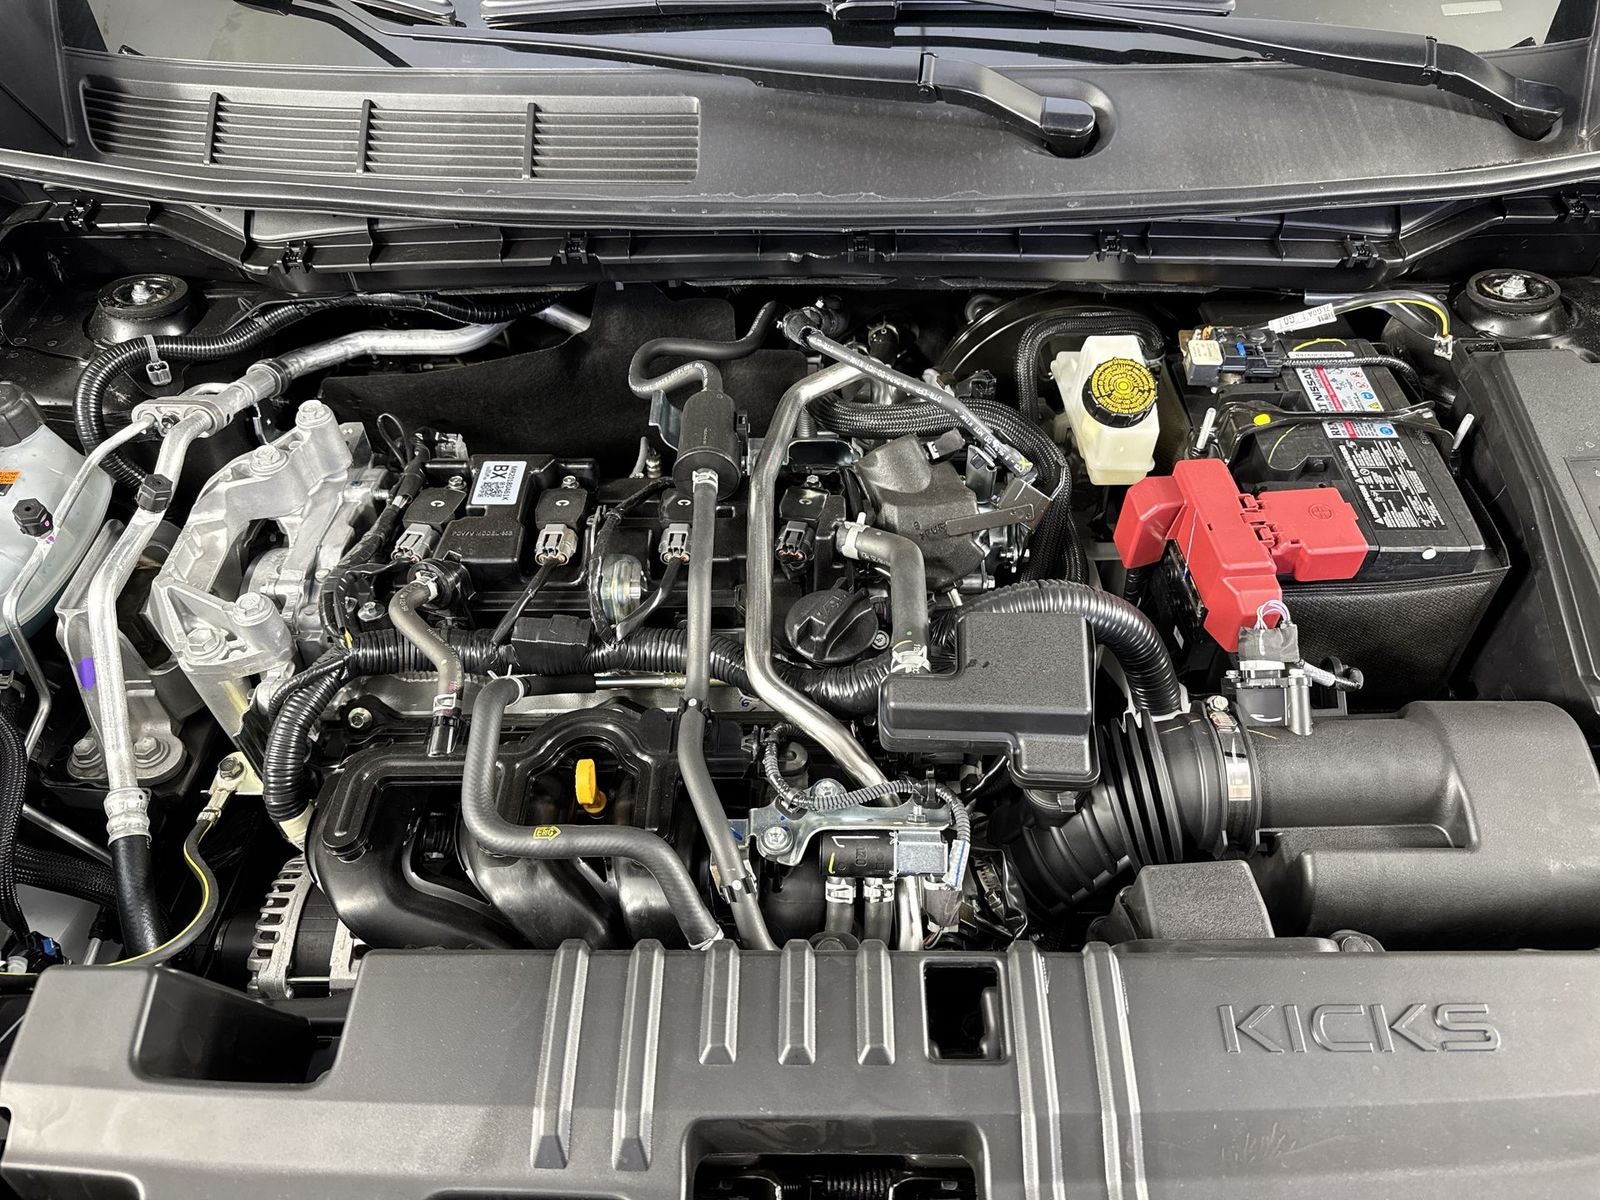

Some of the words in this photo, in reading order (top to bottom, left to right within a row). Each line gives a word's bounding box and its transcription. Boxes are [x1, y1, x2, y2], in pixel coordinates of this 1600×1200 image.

[1302, 367, 1323, 401] NISSAN
[490, 465, 509, 479] BX
[1218, 1003, 1501, 1053] KICKS
